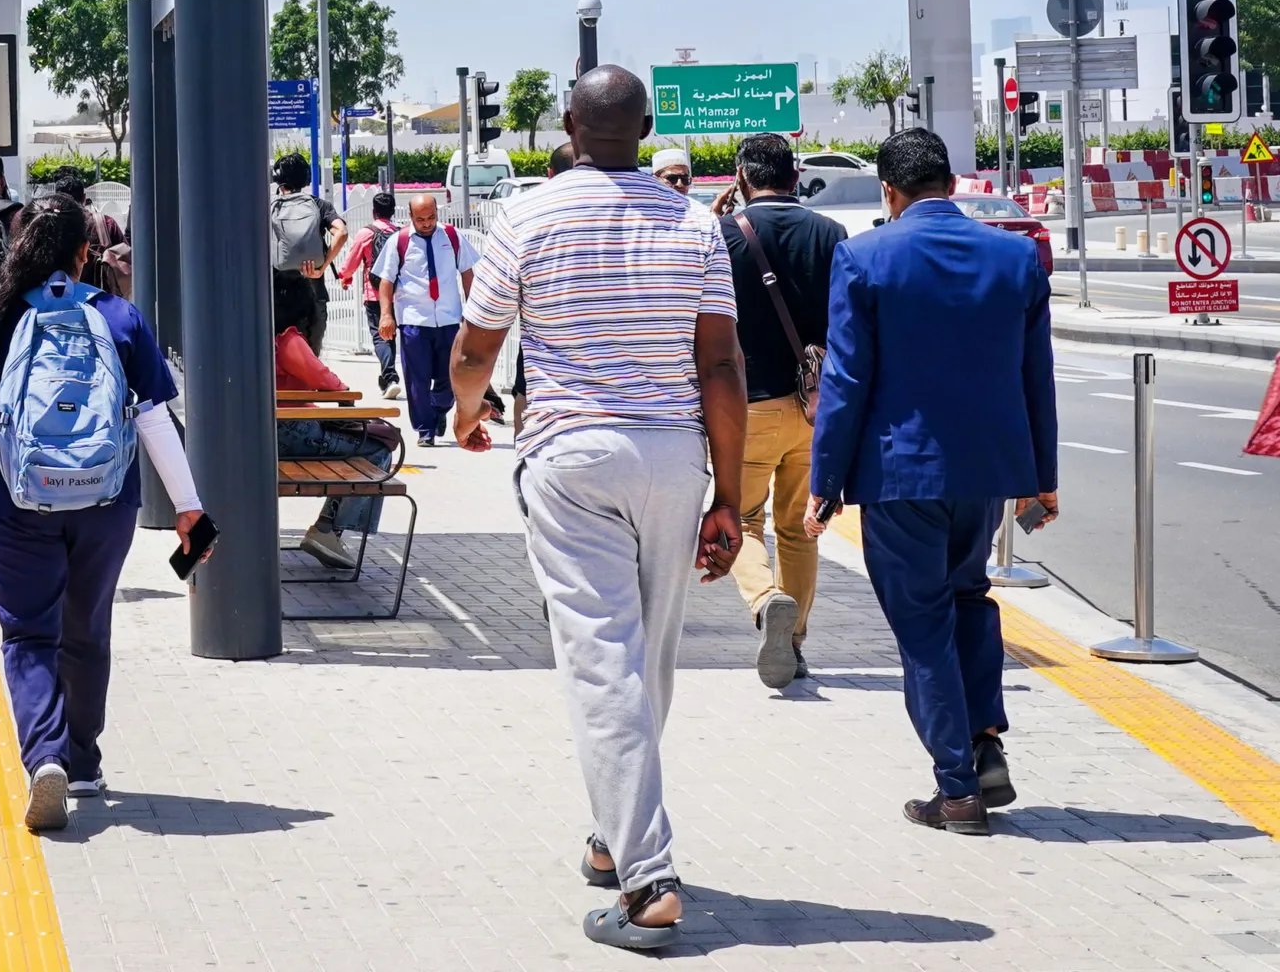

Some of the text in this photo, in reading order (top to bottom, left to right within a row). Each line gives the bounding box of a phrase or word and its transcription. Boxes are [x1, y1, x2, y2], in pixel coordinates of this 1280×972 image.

[734, 68, 772, 82] الممزر
[692, 87, 773, 102] ميناء الحمرية
[660, 100, 677, 111] 93
[683, 107, 740, 117] Al Mamzar
[684, 117, 767, 130] Al Hamriya Port
[68, 475, 104, 487] Passion
